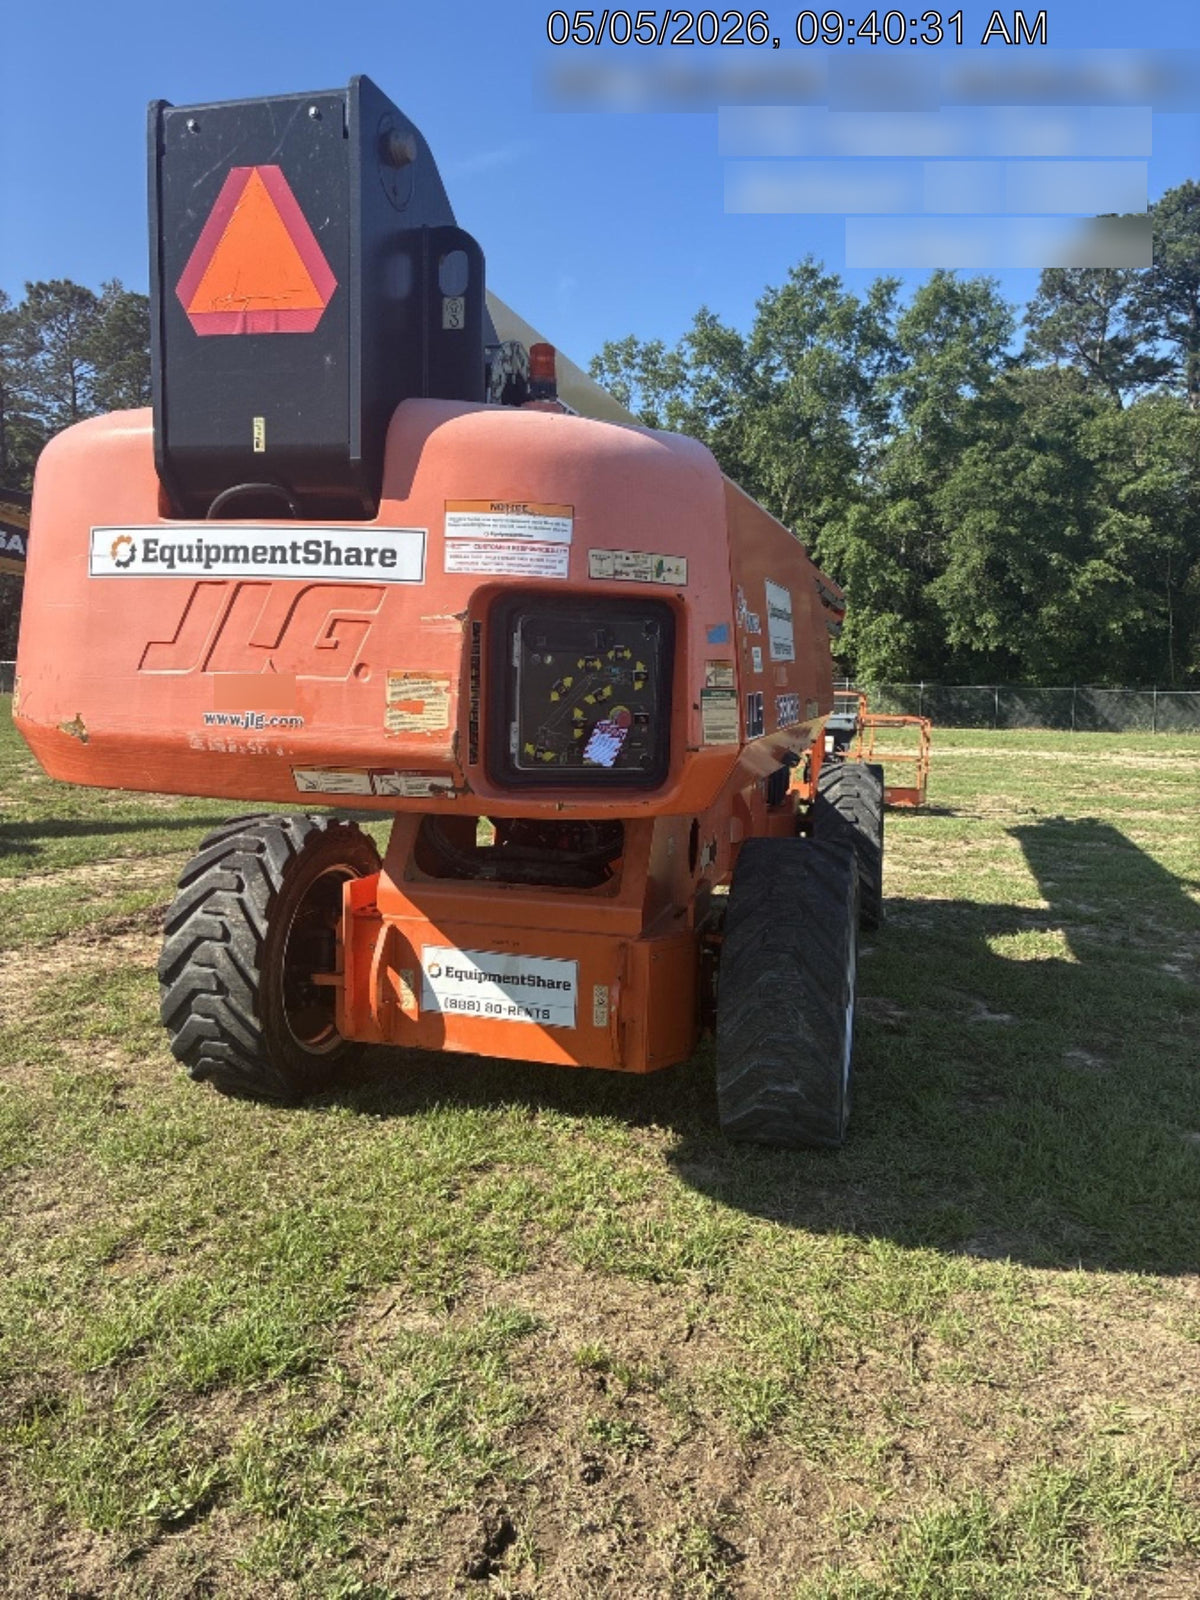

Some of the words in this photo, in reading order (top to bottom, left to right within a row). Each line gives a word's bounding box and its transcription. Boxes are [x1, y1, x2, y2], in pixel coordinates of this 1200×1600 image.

[141, 537, 398, 570] EquipmentShare
[203, 711, 305, 731] www.jlg.com
[444, 966, 572, 991] EquipmentShare
[443, 998, 482, 1013] (888)
[484, 1001, 551, 1020] 80-RENTS
